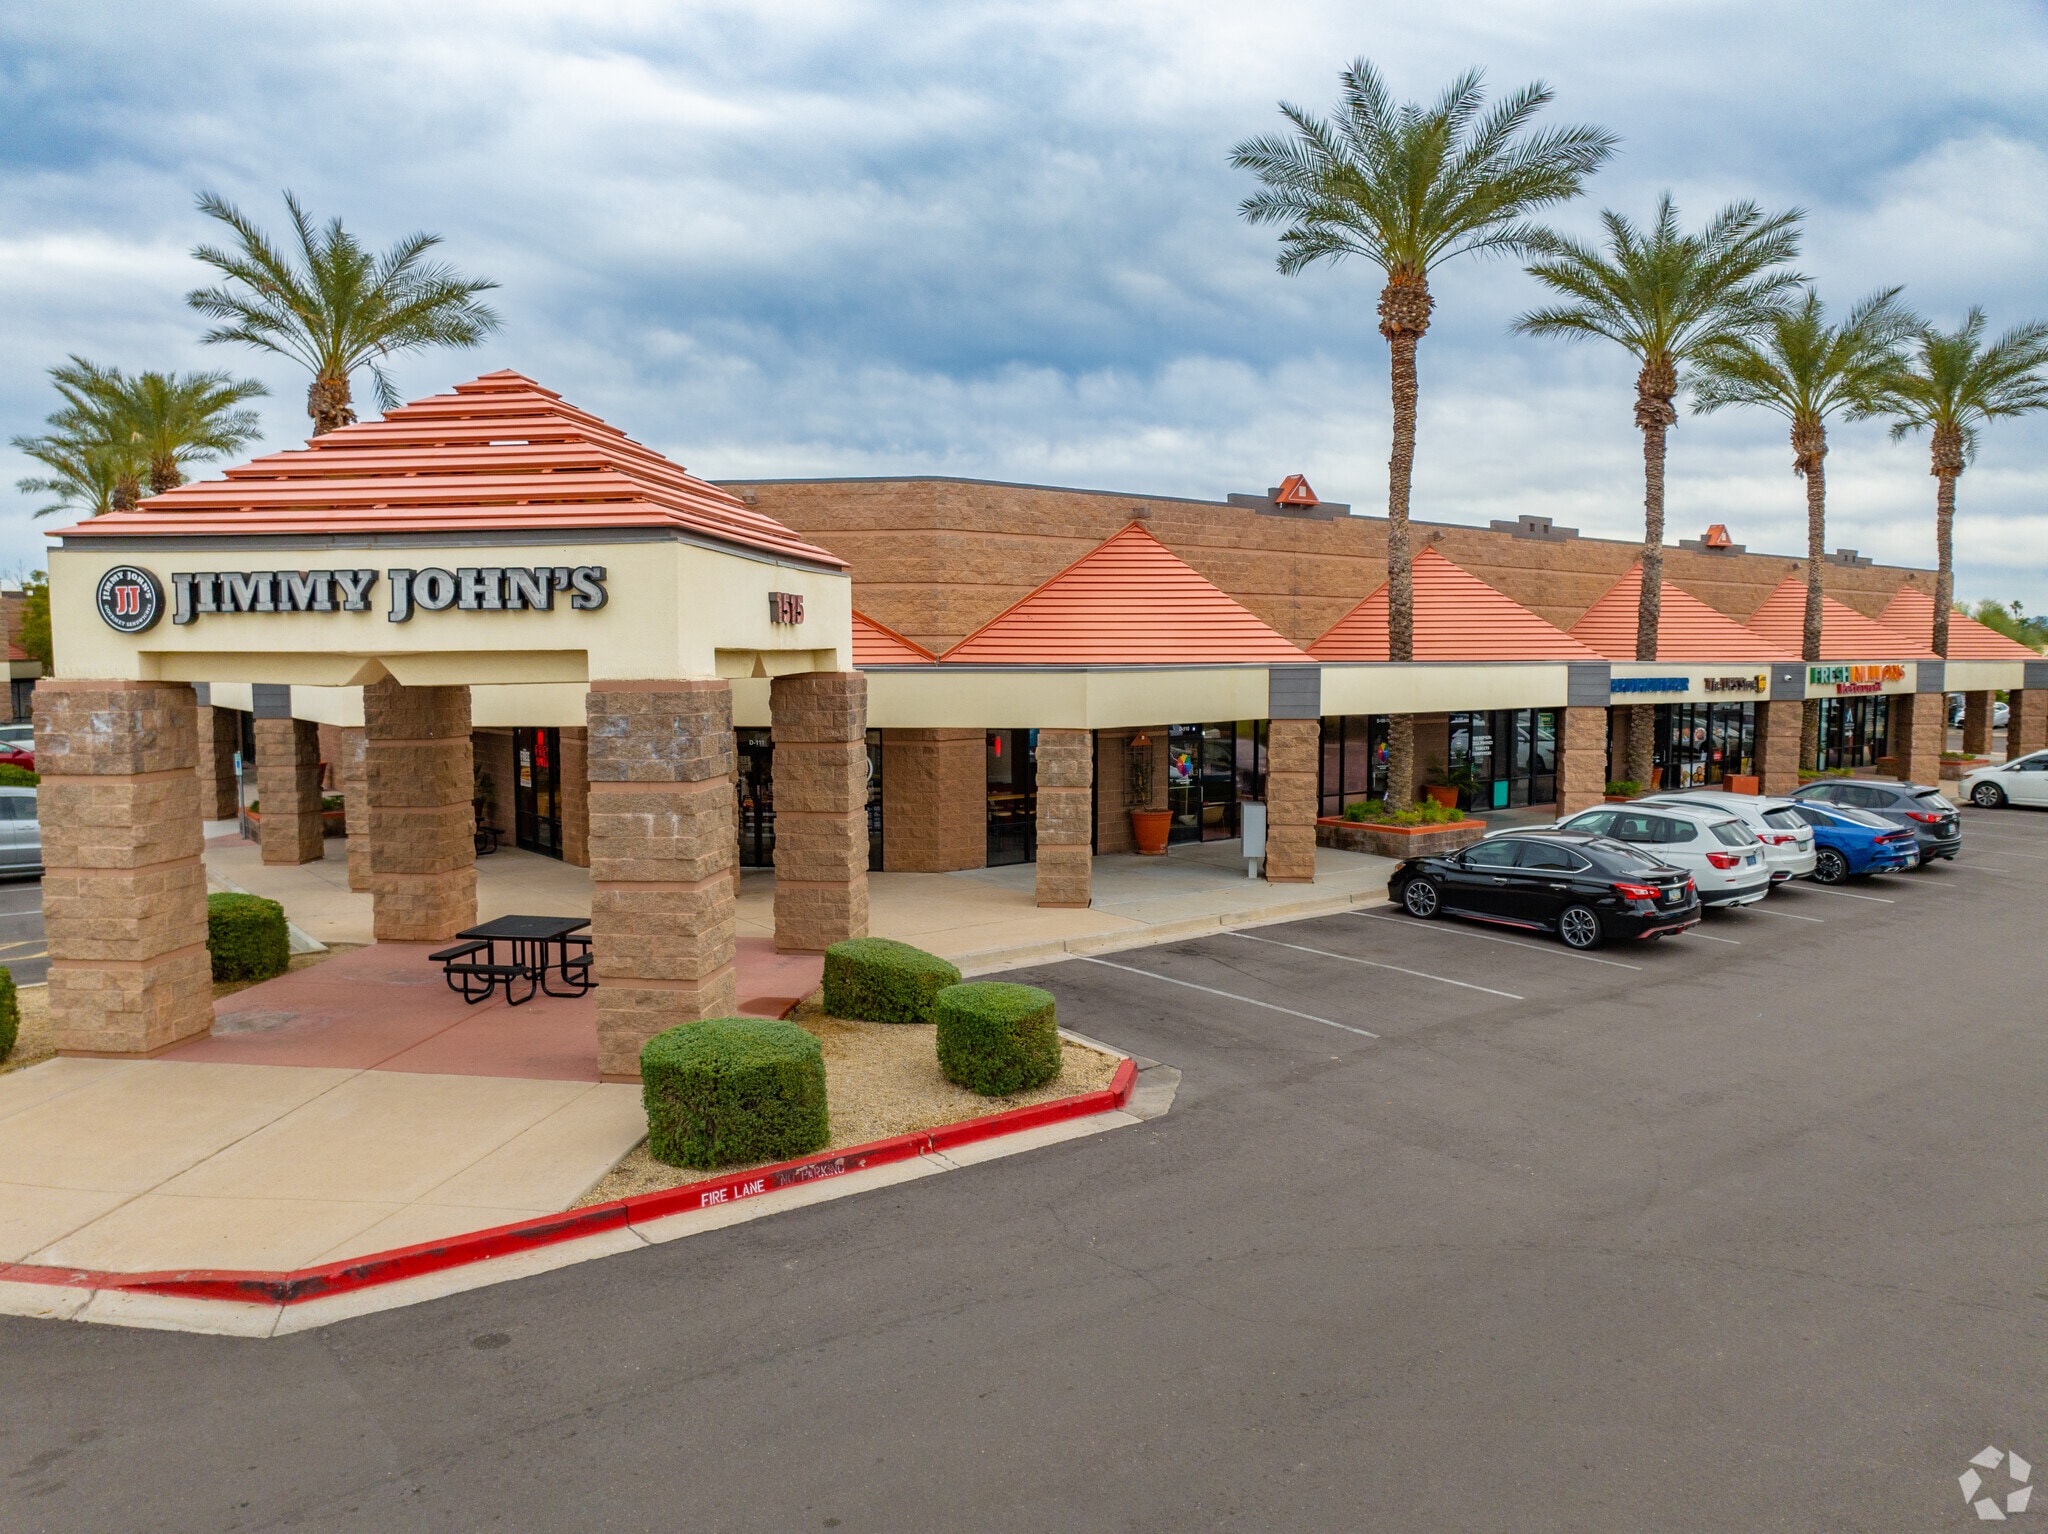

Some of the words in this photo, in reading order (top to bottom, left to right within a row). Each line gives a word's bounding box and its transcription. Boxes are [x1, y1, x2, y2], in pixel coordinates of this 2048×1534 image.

[102, 571, 124, 600] JIMMY
[127, 571, 152, 599] JOHN'S
[172, 568, 379, 626] JIMMY
[388, 565, 608, 625] JOHN'S
[115, 586, 140, 615] JJ
[770, 591, 804, 624] 1515
[1811, 667, 1850, 684] FRESH
[701, 1188, 729, 1208] FIRE
[734, 1179, 765, 1199] LANE
